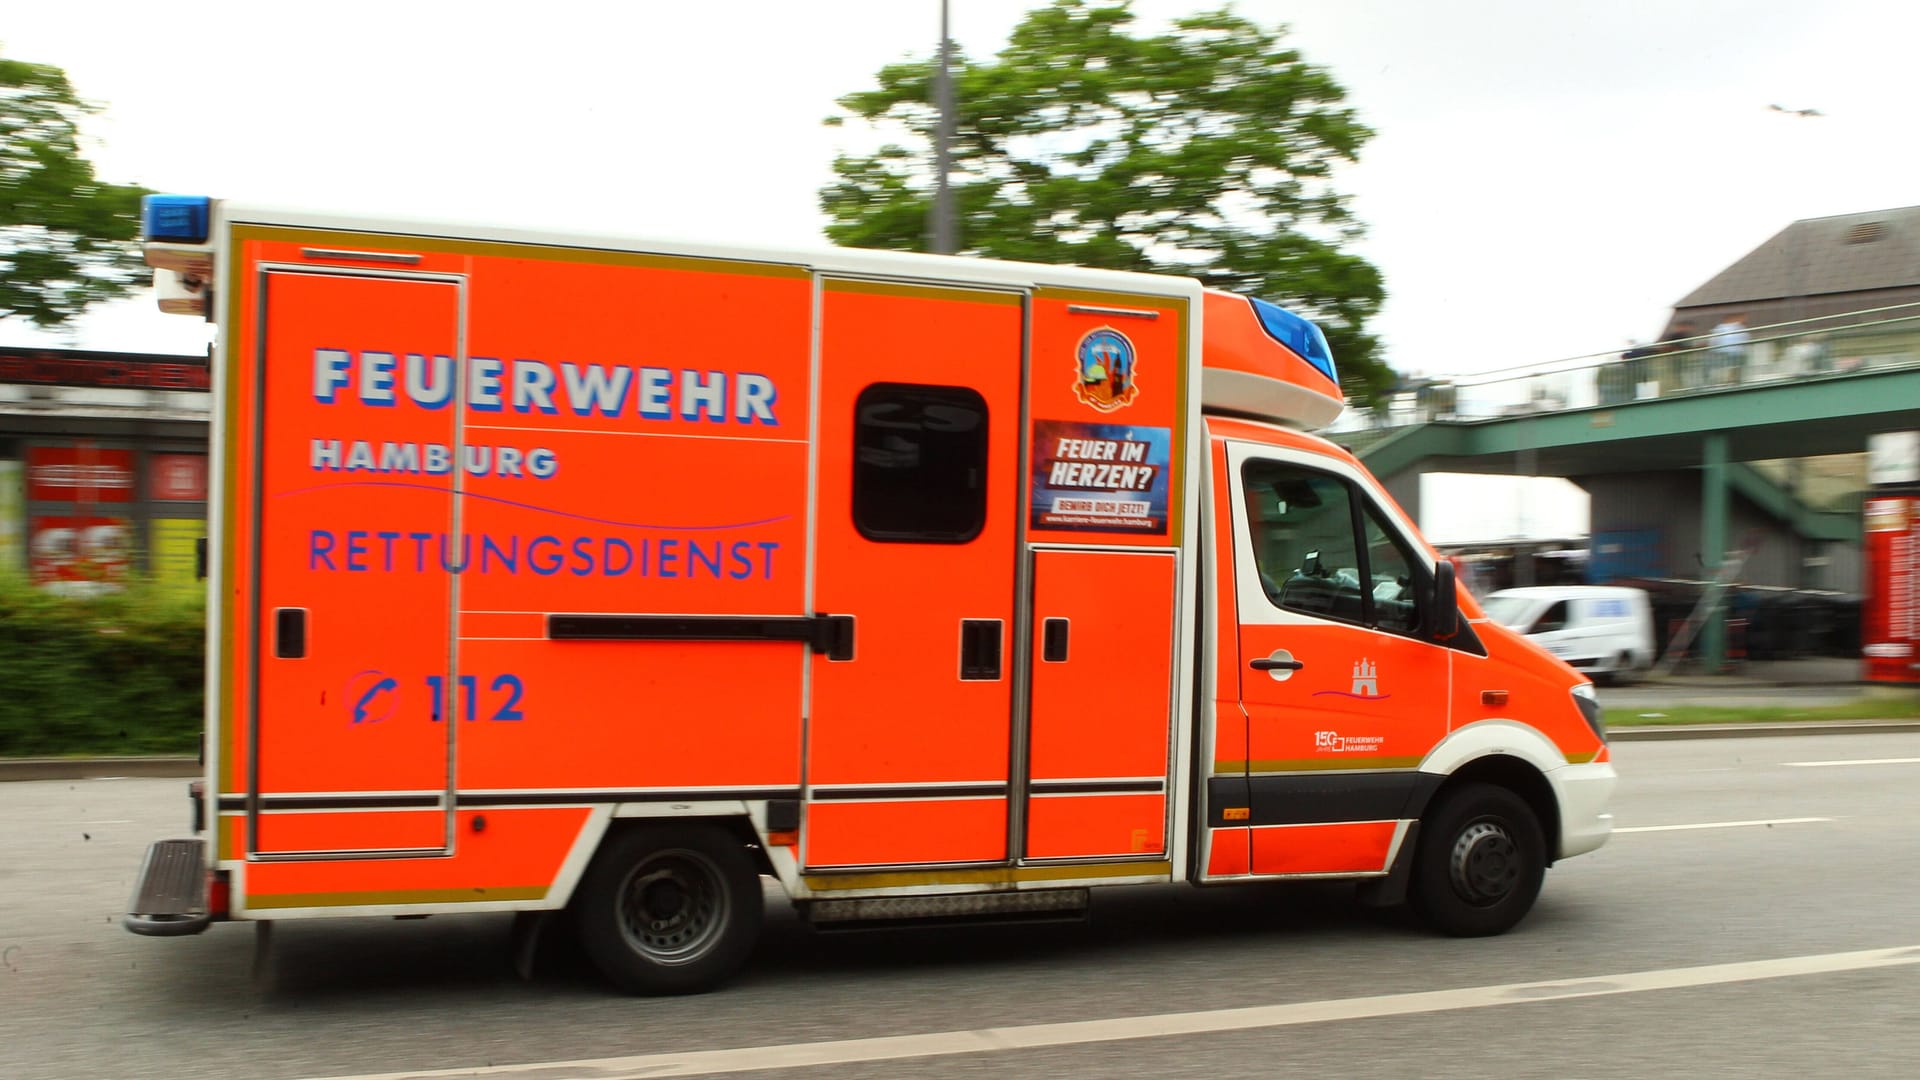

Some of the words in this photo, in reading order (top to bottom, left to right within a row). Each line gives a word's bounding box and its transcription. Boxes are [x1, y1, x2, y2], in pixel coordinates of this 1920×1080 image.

[313, 347, 780, 427] FEUERWEHR
[310, 438, 559, 480] HAMBURG
[1056, 438, 1117, 460] FEUER
[1120, 442, 1144, 461] IM
[1049, 462, 1152, 489] HERZEN?
[310, 530, 780, 580] RETTUNGSDIENST
[426, 673, 525, 722] 112
[1345, 736, 1384, 744] FEUERWEHR
[1345, 744, 1378, 752] HAMBURG
